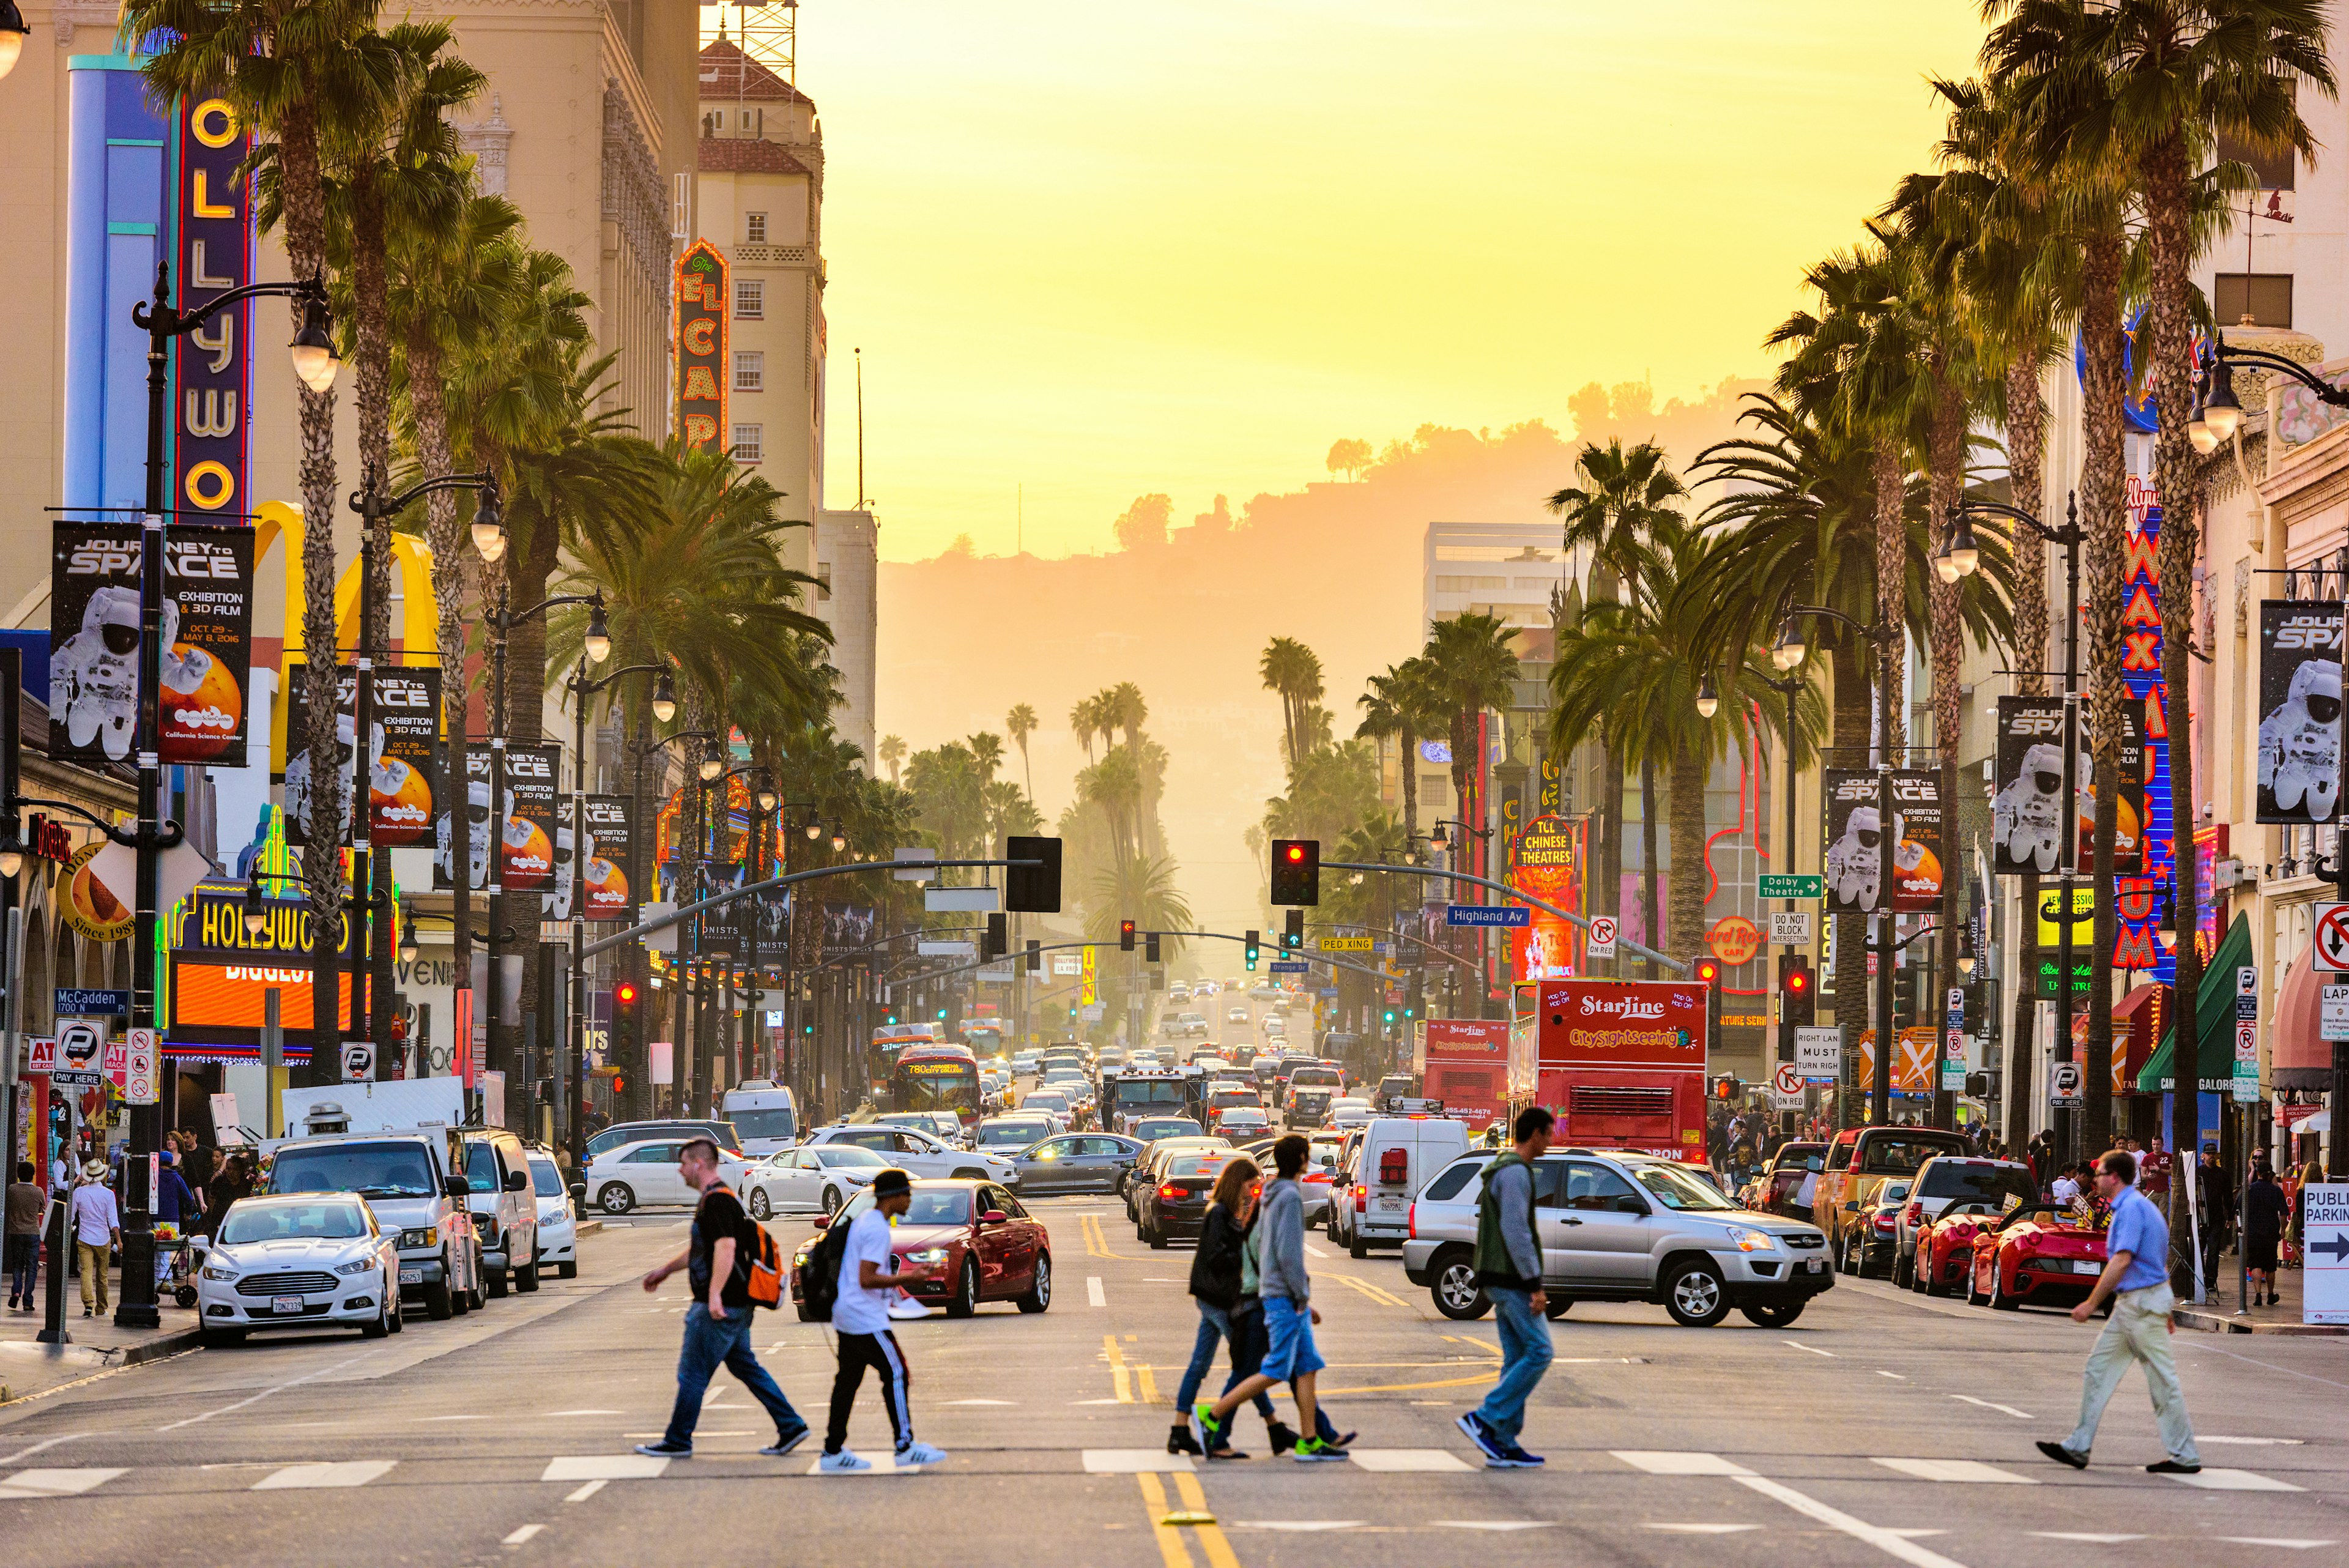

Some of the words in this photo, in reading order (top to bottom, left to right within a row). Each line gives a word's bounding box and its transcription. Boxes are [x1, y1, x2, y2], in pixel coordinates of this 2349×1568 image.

[691, 256, 714, 273] The
[681, 273, 722, 311] EL
[683, 318, 720, 449] CAP
[74, 539, 213, 554] JOURNEY
[179, 591, 243, 604] EXHIBITION
[2121, 527, 2162, 672] WAX
[180, 604, 189, 614] &
[191, 604, 211, 613] 3D
[213, 604, 241, 616] FILM
[2279, 616, 2343, 627] JOUR
[212, 625, 225, 634] 29
[183, 633, 204, 642] MAY
[217, 634, 239, 643] 2016
[337, 678, 410, 688] URNEY
[2014, 708, 2093, 718] JOURN
[384, 716, 433, 726] EXHIBITION
[466, 752, 535, 762] URNEY
[1537, 821, 1555, 833] TCL
[1525, 835, 1567, 849] CHINESE
[63, 847, 102, 877] DÖNE
[1521, 851, 1570, 864] THEATRES
[1768, 877, 1798, 888] Dolby
[1762, 887, 1804, 896] Theatre
[1455, 910, 1503, 924] Highland
[1508, 911, 1523, 923] Av
[1775, 915, 1786, 924] DO
[1790, 915, 1805, 924] NOT
[71, 916, 105, 939] Since
[1778, 925, 1803, 935] BLOCK
[1704, 926, 1734, 943] ard
[1324, 940, 1343, 949] PED
[1084, 951, 1094, 998] INN
[58, 990, 115, 1005] McCadden
[1561, 996, 1571, 1005] Off
[2324, 989, 2348, 1000] LAP
[58, 1003, 76, 1013] 1700
[80, 1004, 86, 1013] N
[1580, 995, 1666, 1020] StarLine
[716, 1014, 725, 1049] ZARA
[1449, 1024, 1486, 1036] StarLine
[32, 1042, 55, 1061] AT
[881, 1042, 892, 1052] 217
[1803, 1048, 1837, 1057] MUST
[908, 1065, 926, 1074] 780
[56, 1073, 72, 1082] PAY
[75, 1074, 98, 1084] HERE
[2199, 1079, 2234, 1091] GALORE
[1778, 1097, 1787, 1105] ON
[2307, 1192, 2349, 1205] PUBLI
[2306, 1208, 2349, 1221] PARKIN
[273, 1302, 302, 1311] 7DNZ339
